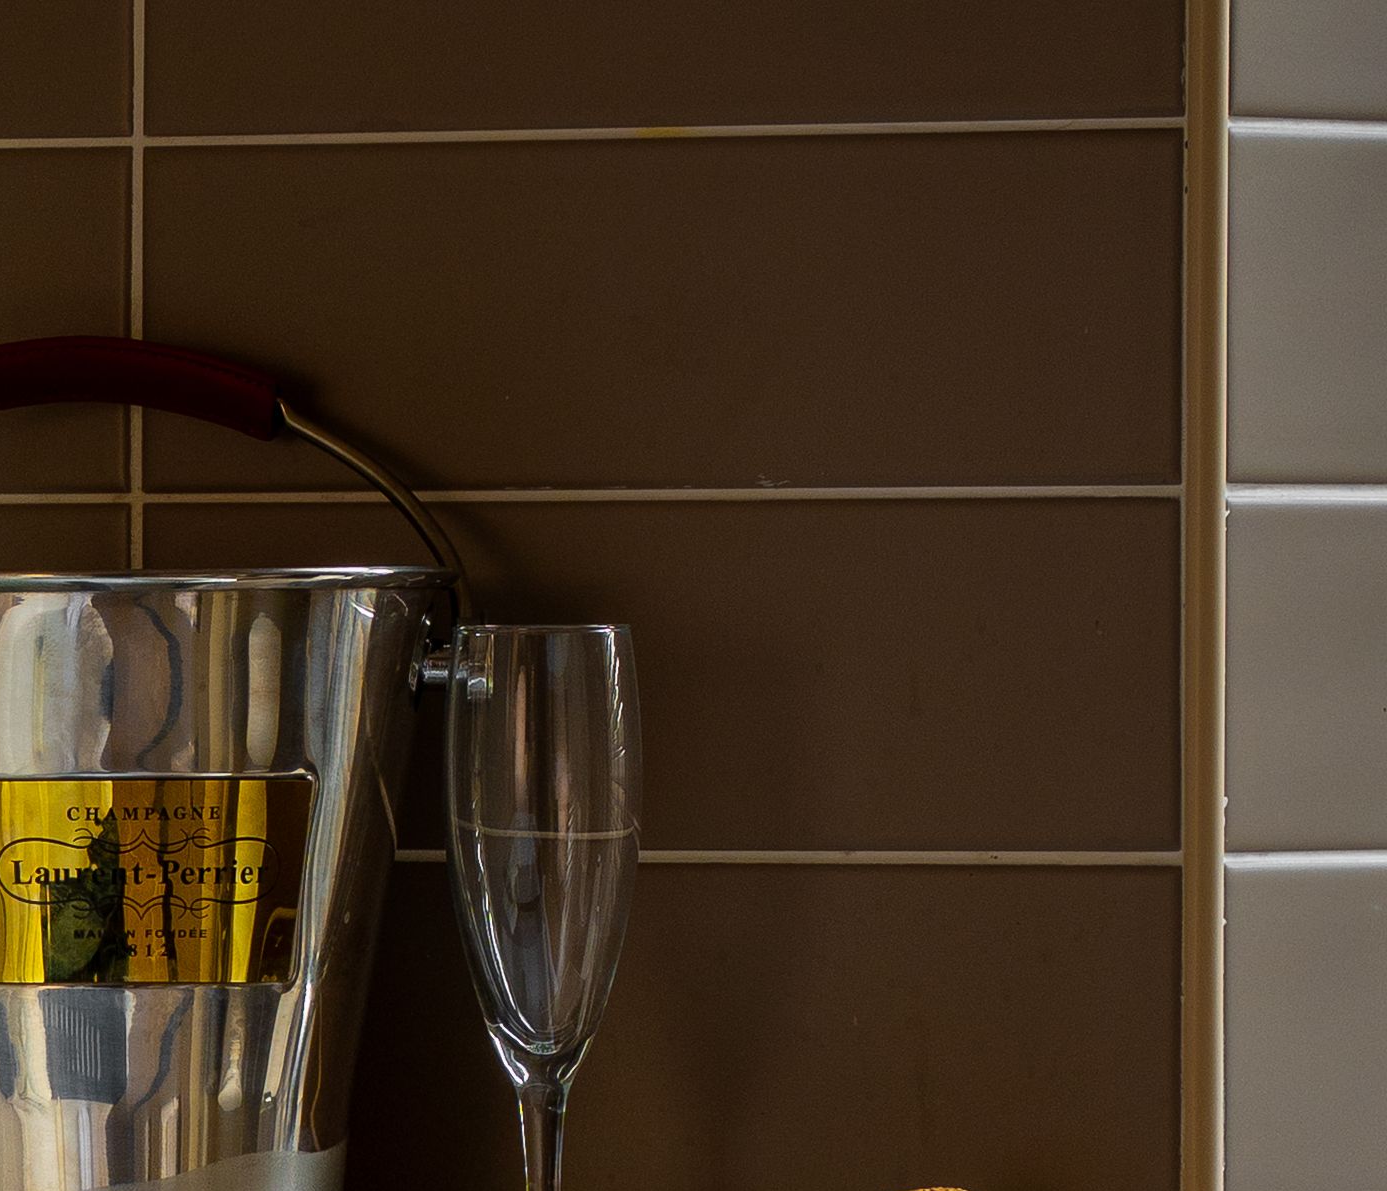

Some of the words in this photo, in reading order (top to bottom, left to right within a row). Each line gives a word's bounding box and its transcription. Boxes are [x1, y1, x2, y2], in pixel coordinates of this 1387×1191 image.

[66, 806, 221, 821] CHAMPAGNE
[11, 860, 268, 886] Laurent-Perrier
[74, 929, 136, 939] MAIN
[145, 926, 208, 939] FODÉE
[115, 943, 170, 957] 812
